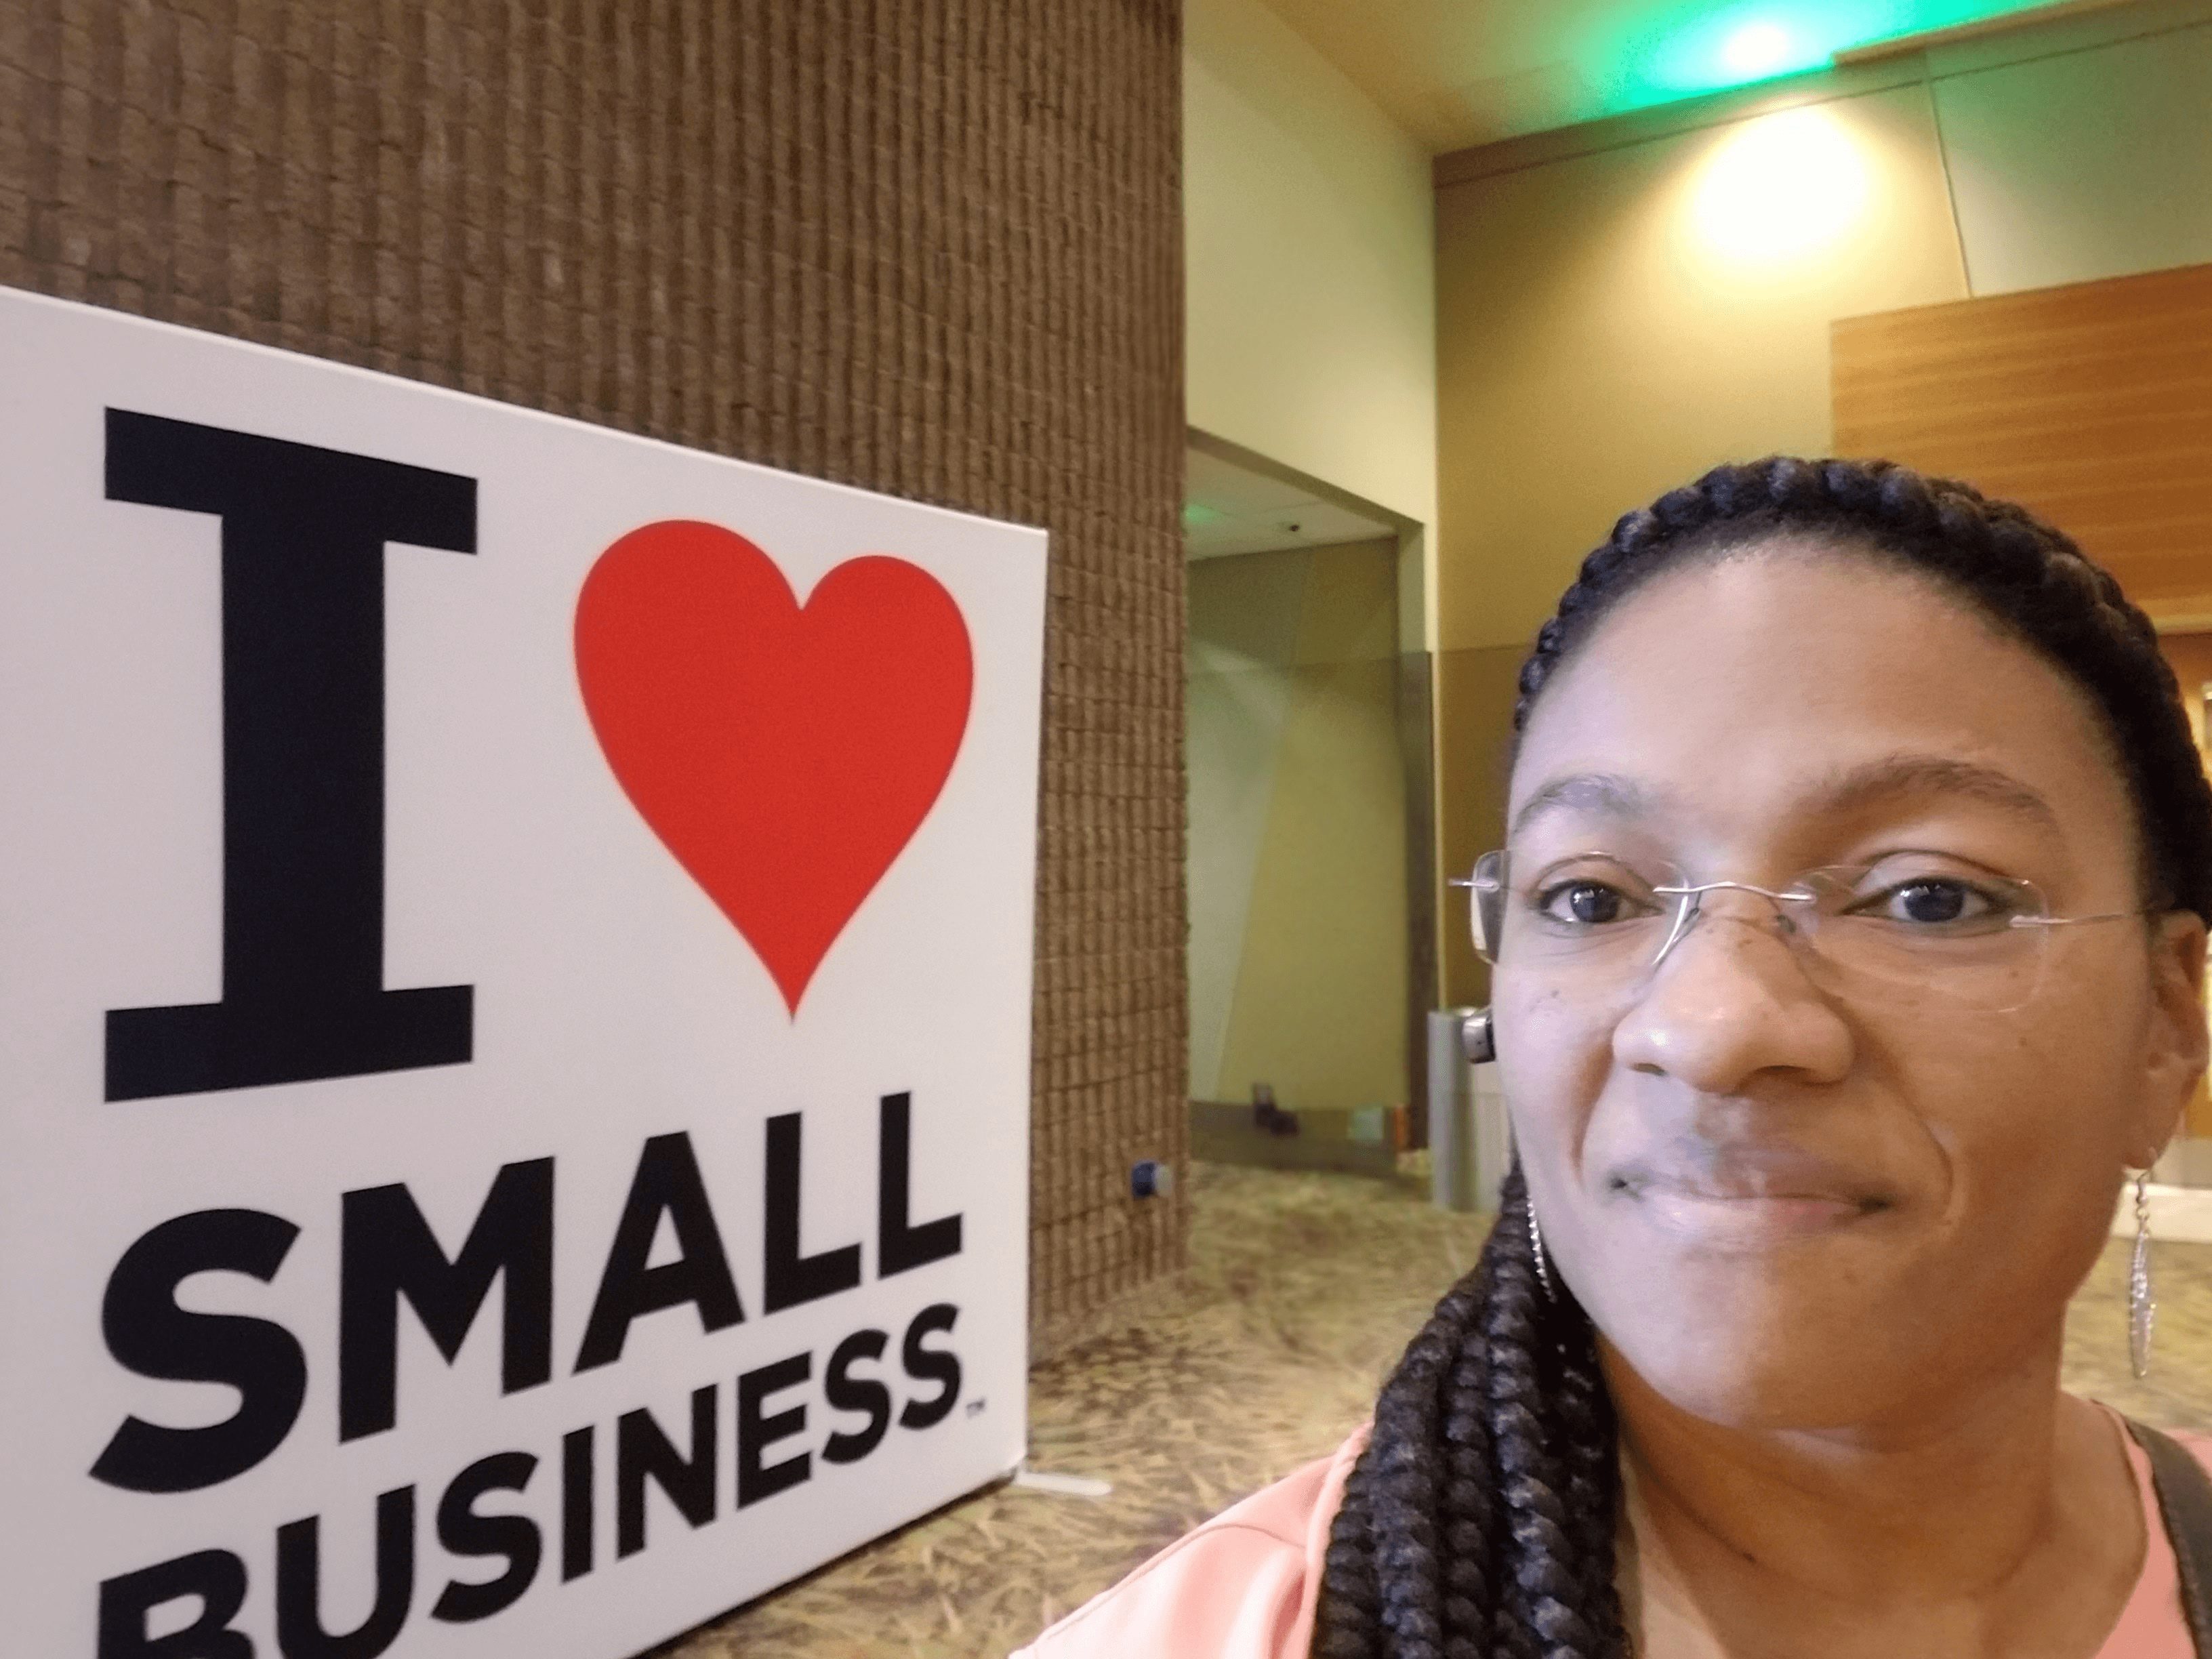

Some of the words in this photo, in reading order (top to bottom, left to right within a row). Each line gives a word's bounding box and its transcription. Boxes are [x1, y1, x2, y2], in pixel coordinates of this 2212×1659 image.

[104, 407, 478, 1103] I
[88, 1092, 962, 1495] SMALL
[96, 1303, 962, 1659] BUSINESS
